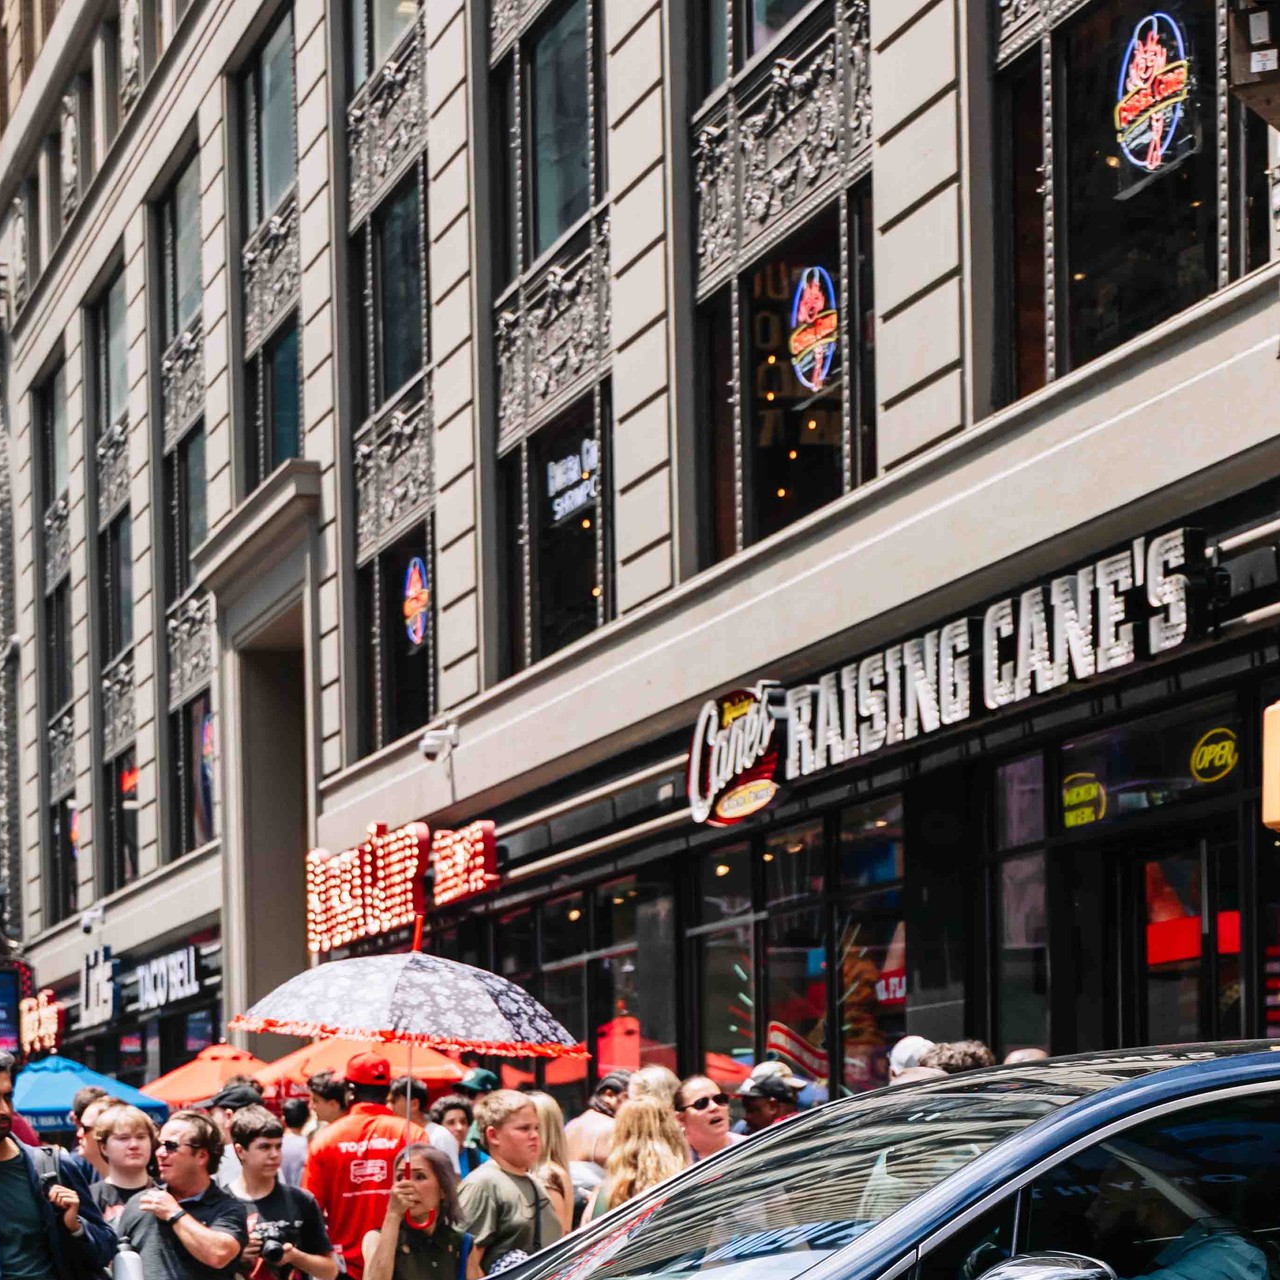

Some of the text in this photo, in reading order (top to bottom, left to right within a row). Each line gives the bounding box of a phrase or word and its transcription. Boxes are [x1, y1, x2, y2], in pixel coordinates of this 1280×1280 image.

[786, 527, 1189, 780] RAISING CANE'S
[1195, 740, 1236, 770] OPEN
[135, 946, 200, 1011] TACO BELL
